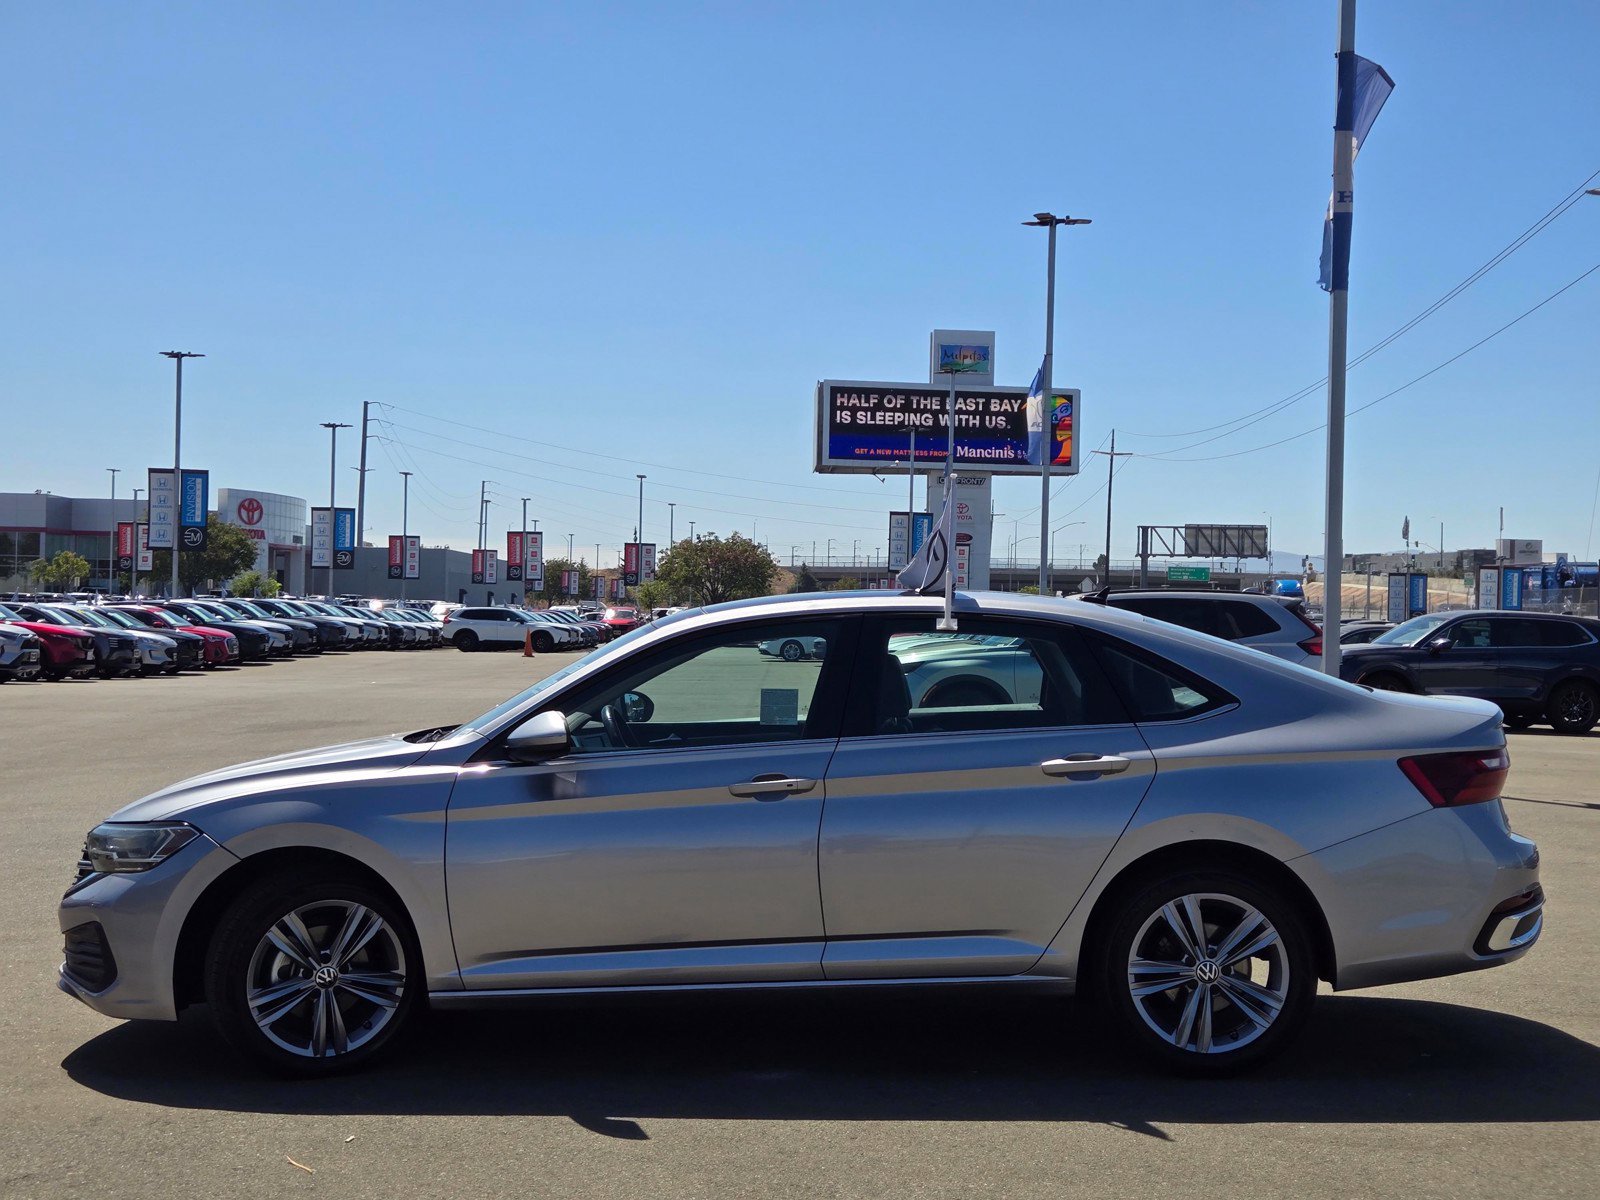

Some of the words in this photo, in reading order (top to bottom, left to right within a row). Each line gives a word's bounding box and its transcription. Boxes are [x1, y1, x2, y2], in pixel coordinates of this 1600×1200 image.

[836, 393, 878, 407] HALF
[884, 395, 905, 408] OF
[910, 396, 940, 410] THE
[990, 398, 1022, 412] BAY
[836, 410, 851, 424] IS
[856, 411, 934, 426] SLEEPING
[938, 414, 979, 428] WITH
[985, 415, 1011, 429] US.
[956, 445, 1015, 459] Mancini's
[186, 477, 196, 522] ENVISION
